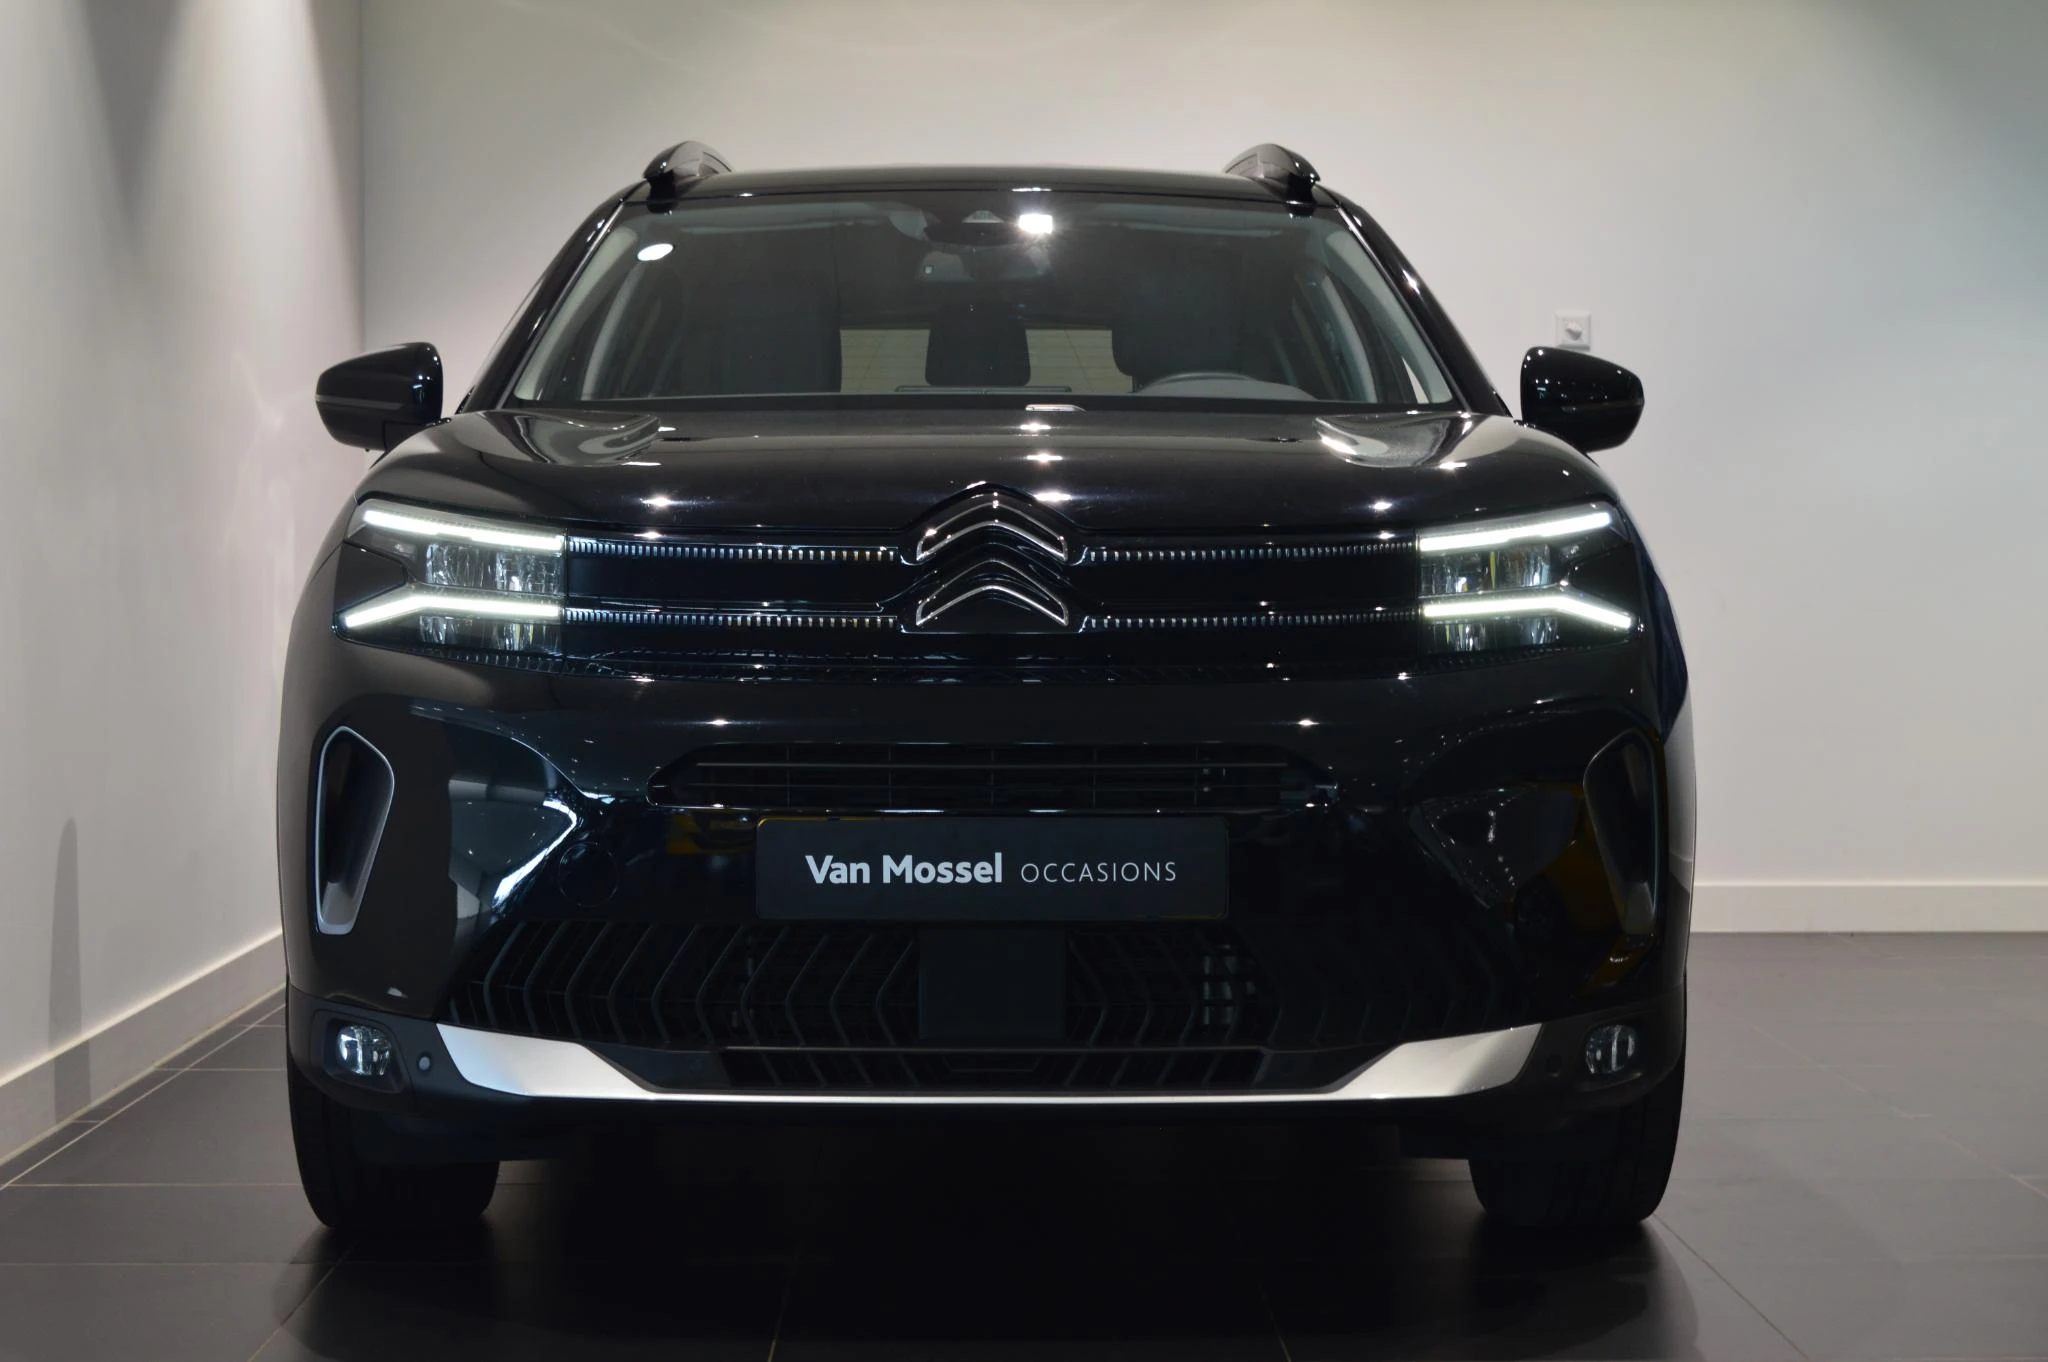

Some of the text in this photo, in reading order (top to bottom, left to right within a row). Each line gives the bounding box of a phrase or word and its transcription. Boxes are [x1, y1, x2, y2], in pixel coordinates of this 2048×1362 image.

[805, 852, 1177, 884] Van Mossel OCCASIONS
